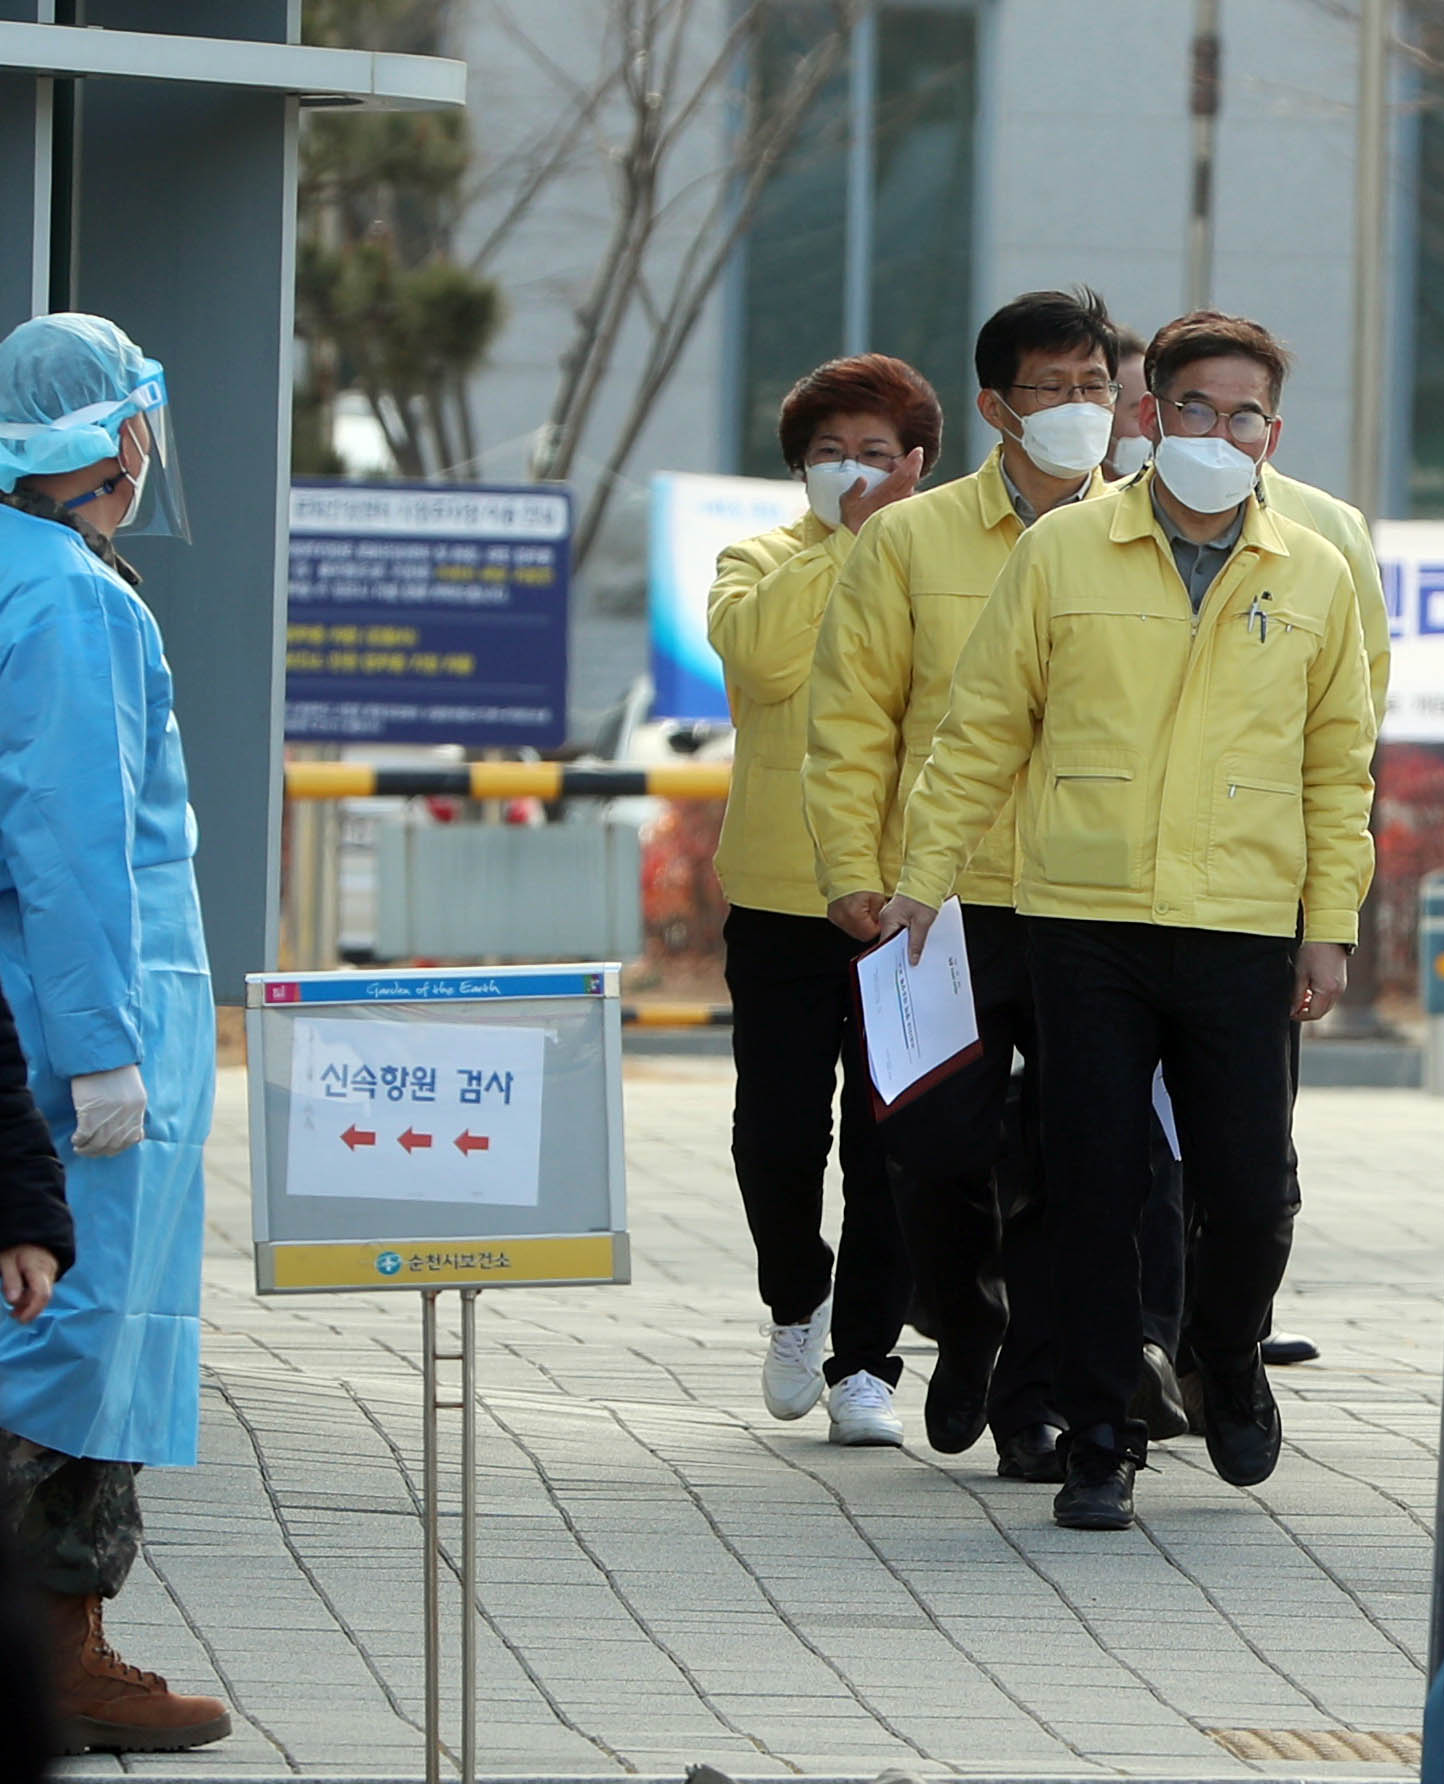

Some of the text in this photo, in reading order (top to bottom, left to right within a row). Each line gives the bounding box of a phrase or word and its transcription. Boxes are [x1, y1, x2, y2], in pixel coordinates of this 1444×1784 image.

[366, 979, 502, 998] Garden of the Earth
[320, 1063, 514, 1105] 신속항원 검사
[408, 1252, 512, 1272] 순천시보건소
